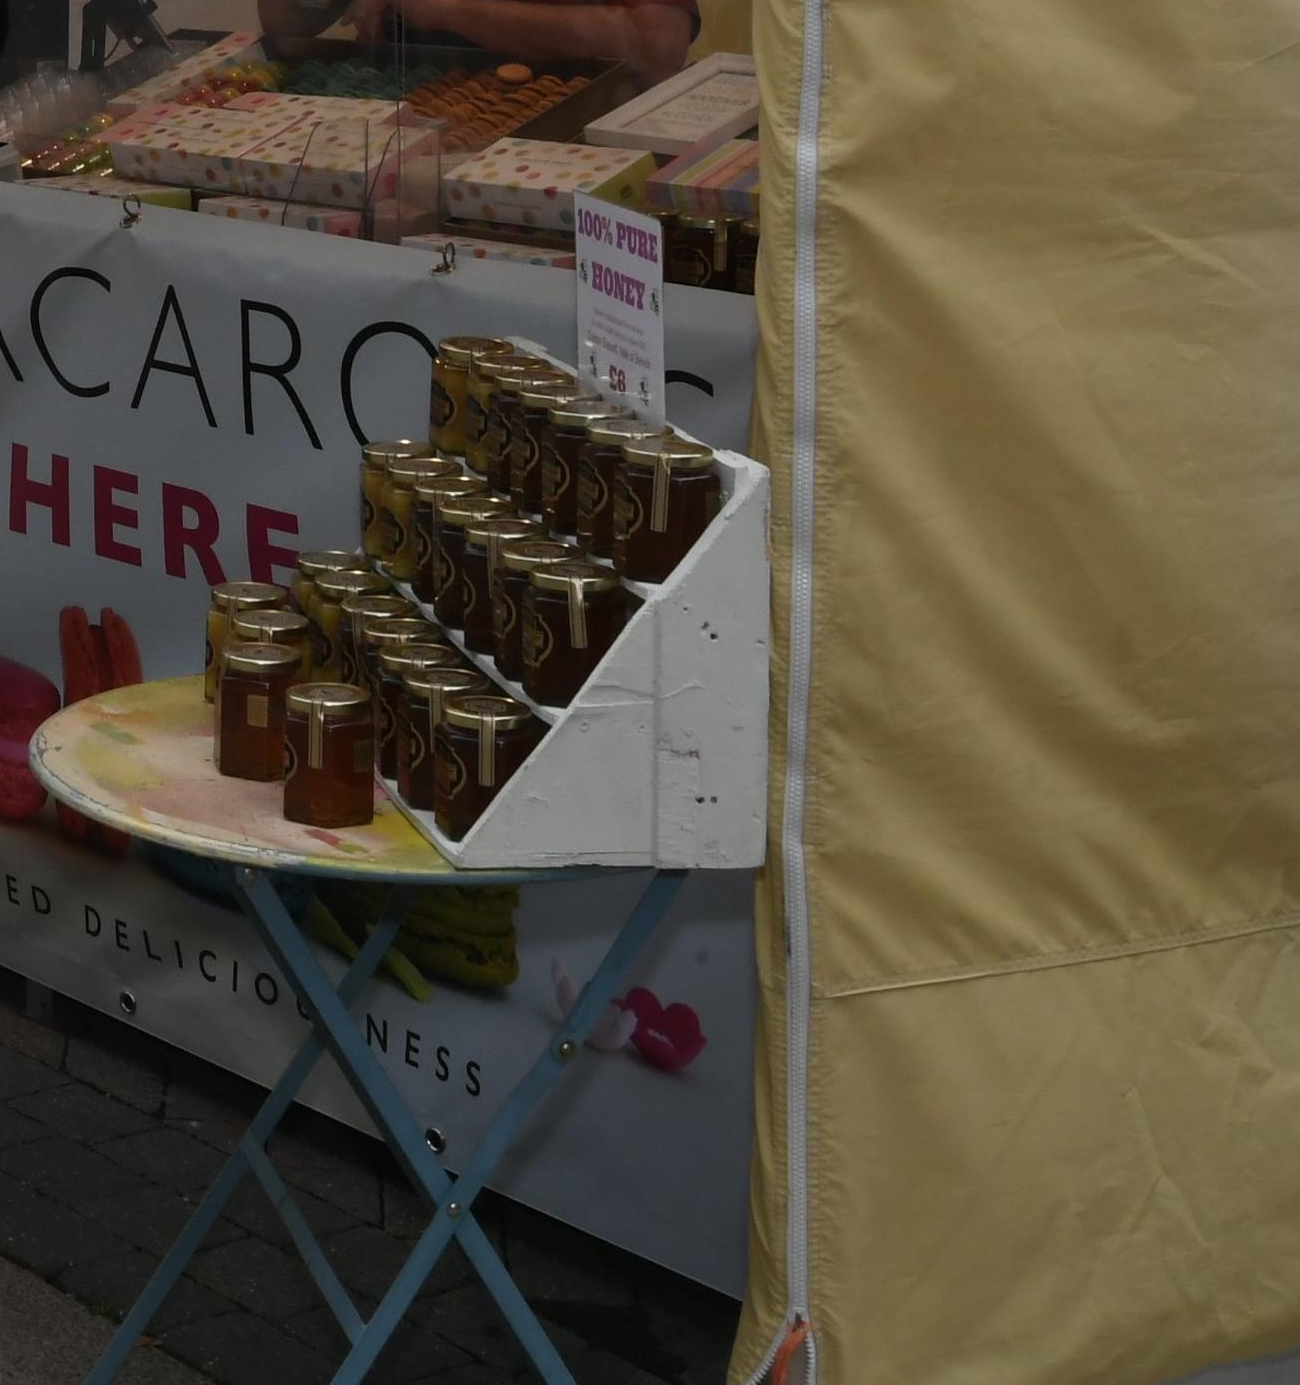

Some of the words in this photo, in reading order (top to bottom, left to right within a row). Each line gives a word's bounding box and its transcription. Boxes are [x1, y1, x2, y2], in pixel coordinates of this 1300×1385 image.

[578, 208, 613, 246] 100%
[615, 222, 658, 264] PURE
[591, 261, 646, 311] HONEY
[9, 443, 301, 594] HERE
[85, 903, 482, 1098] DELICIONESS
